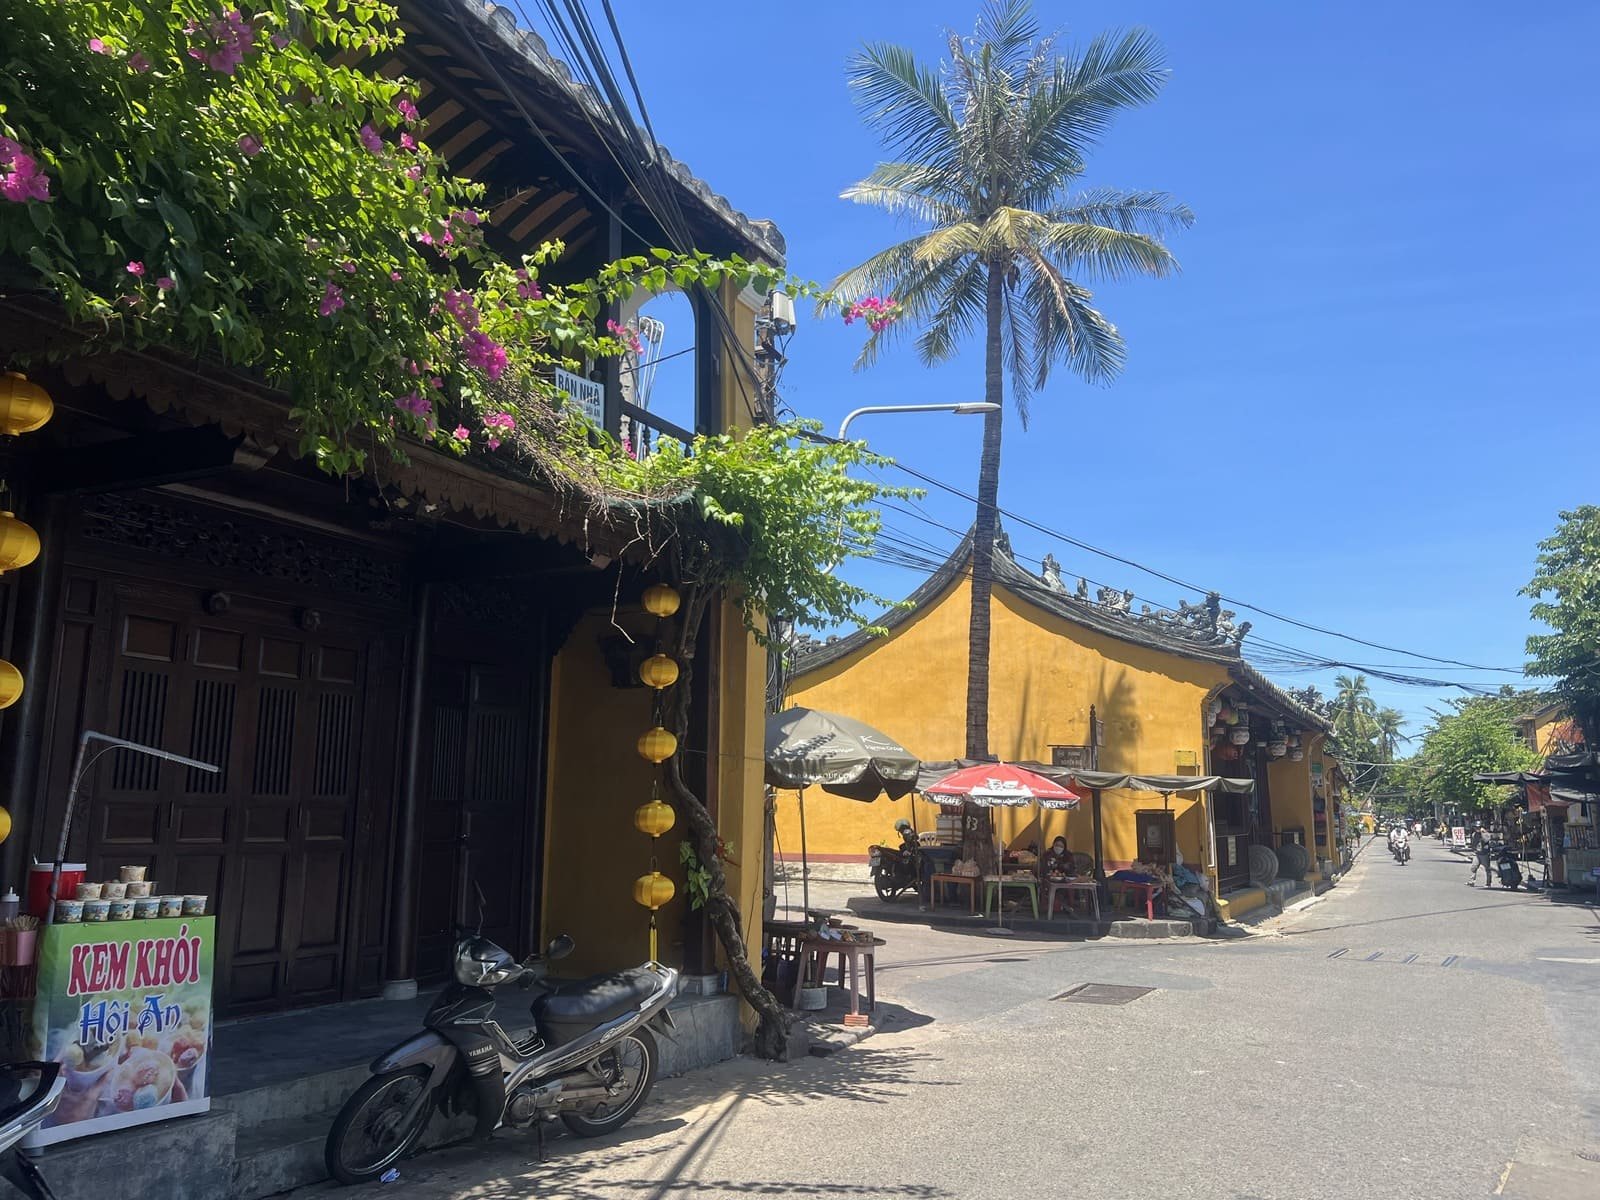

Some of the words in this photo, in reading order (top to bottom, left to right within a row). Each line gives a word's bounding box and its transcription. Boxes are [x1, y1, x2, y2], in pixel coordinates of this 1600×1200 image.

[68, 942, 131, 996] KEM
[133, 924, 201, 989] KHÓI
[79, 1000, 129, 1044] Hội
[138, 995, 181, 1036] An
[468, 1044, 493, 1057] YAMAHA
